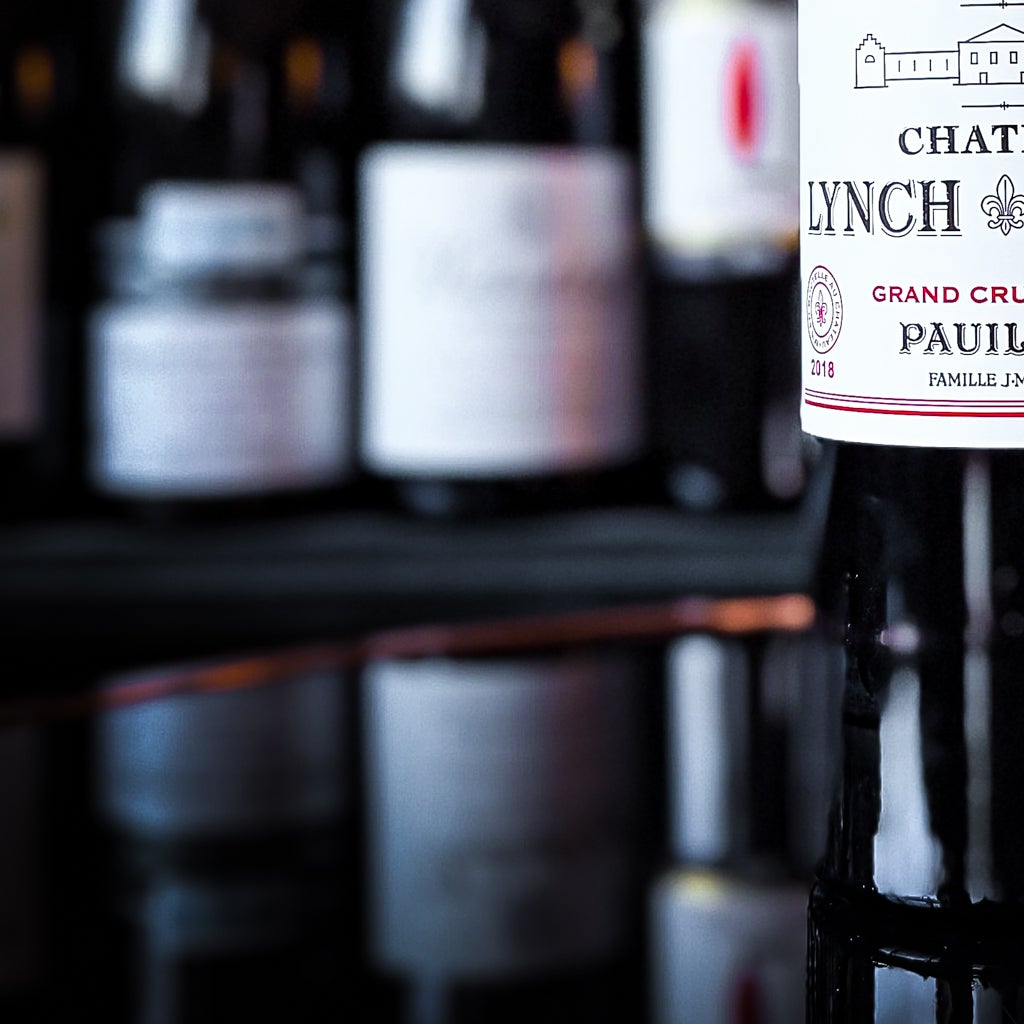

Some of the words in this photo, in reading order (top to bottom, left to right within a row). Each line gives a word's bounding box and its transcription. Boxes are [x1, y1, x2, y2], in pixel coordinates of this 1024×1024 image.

[807, 178, 962, 238] LYNCH
[871, 285, 959, 304] GRAND
[810, 358, 835, 379] 2018
[928, 371, 997, 388] FAMILLE
